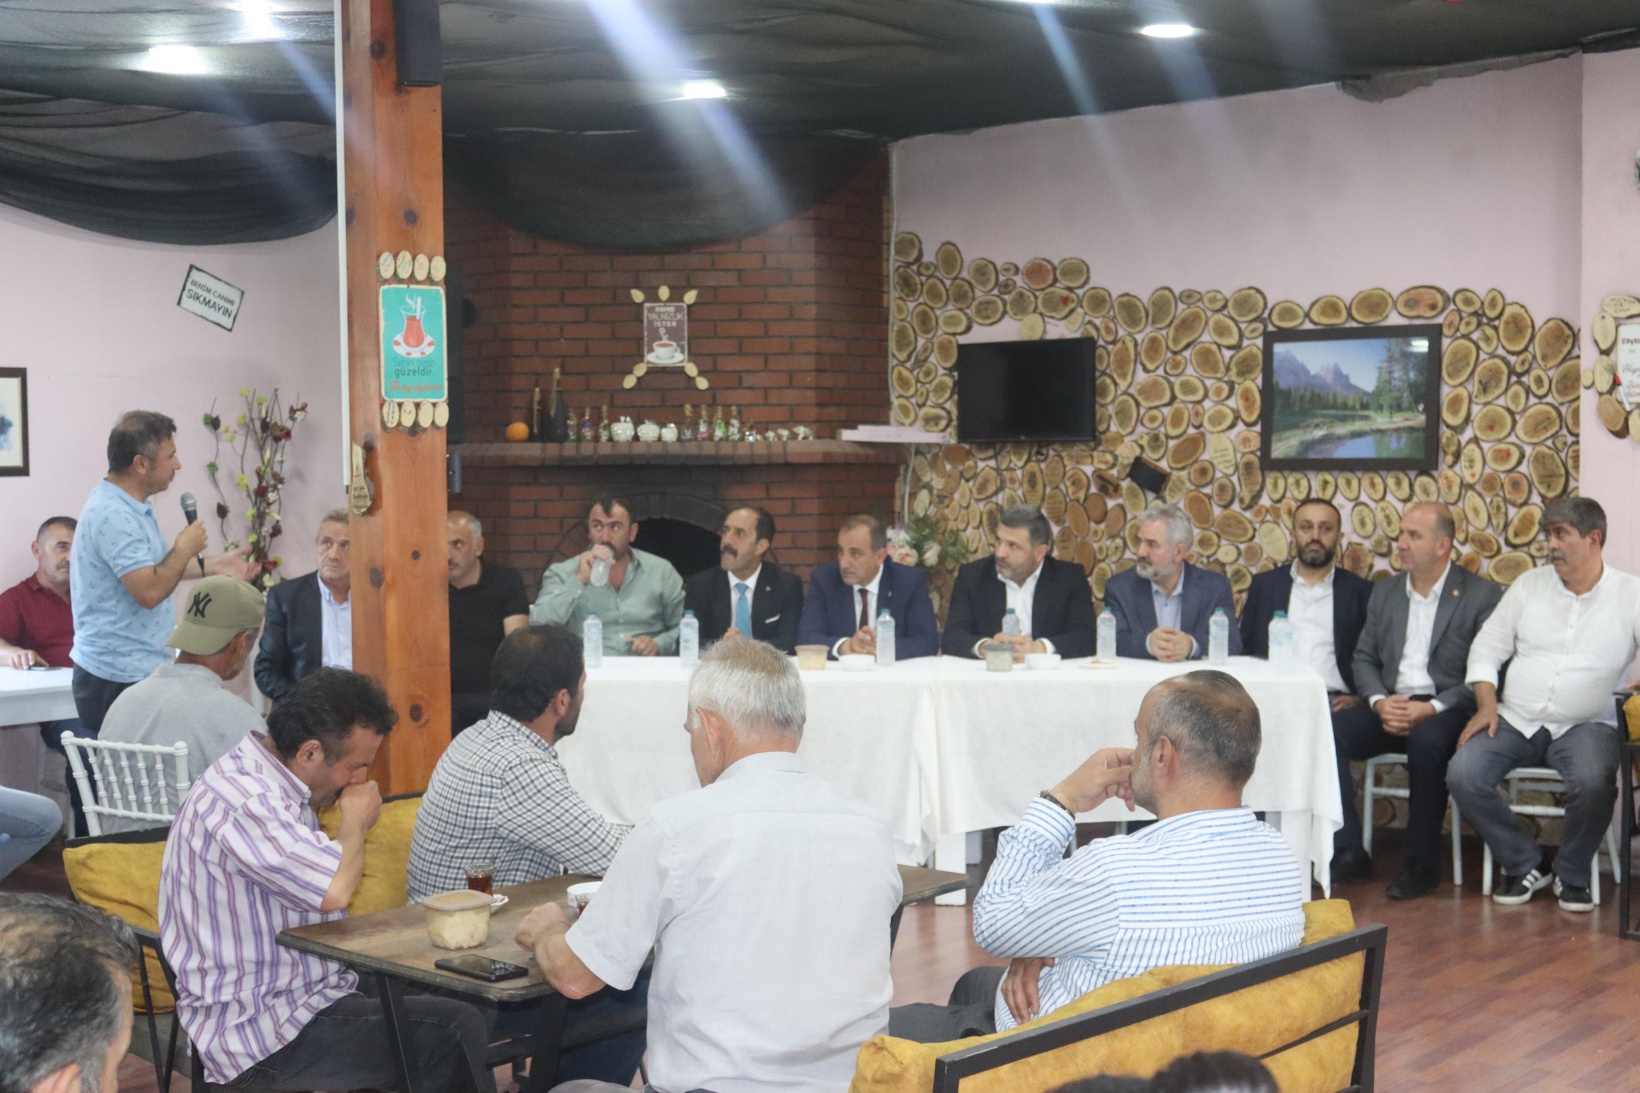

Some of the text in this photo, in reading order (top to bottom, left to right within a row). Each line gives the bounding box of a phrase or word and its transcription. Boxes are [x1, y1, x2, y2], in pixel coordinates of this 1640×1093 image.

[186, 288, 233, 319] SIKMAYIN
[394, 366, 436, 379] güzeldir.
[187, 591, 213, 619] NY
